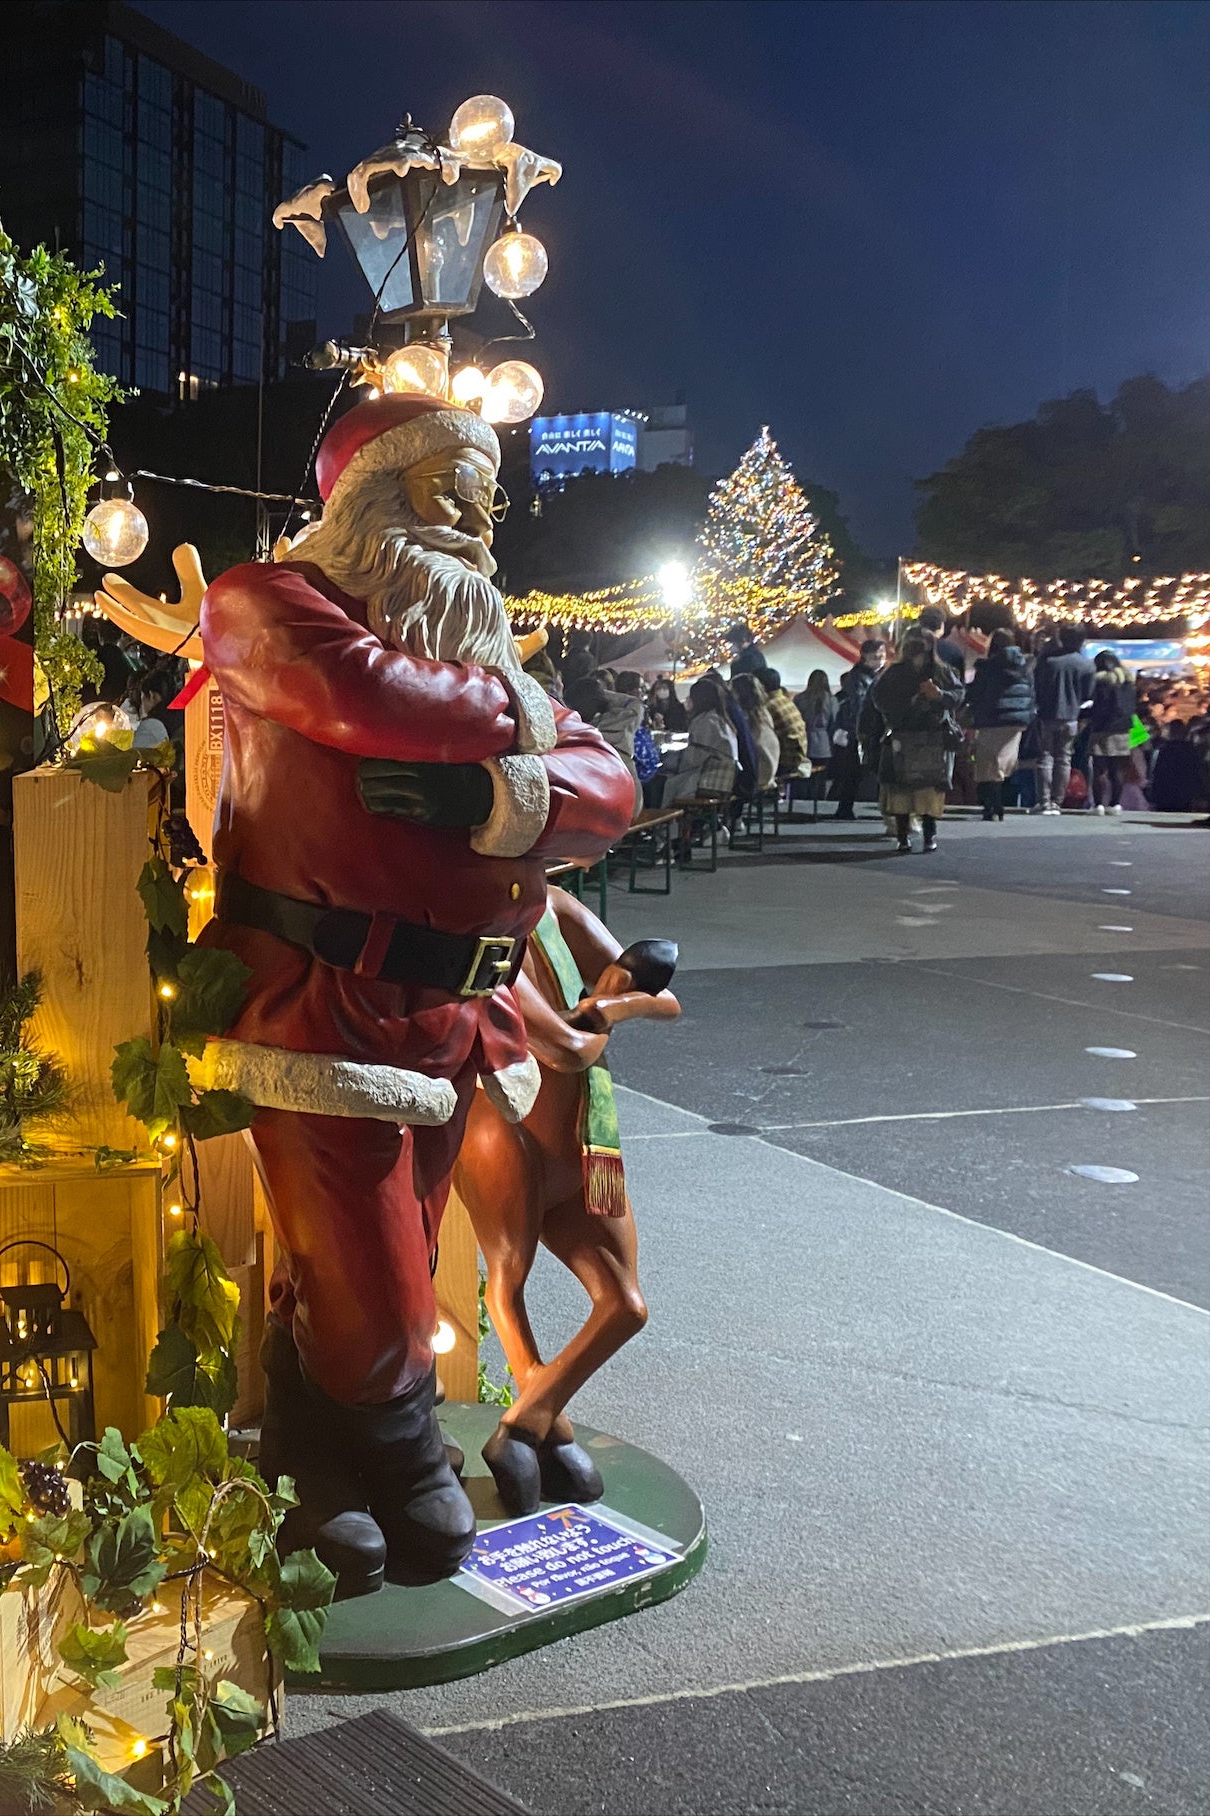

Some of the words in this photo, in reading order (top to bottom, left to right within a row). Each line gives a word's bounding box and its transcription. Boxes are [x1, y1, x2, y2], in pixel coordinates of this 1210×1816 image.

[535, 440, 606, 455] AVANTIA
[493, 1564, 545, 1588] Please
[545, 1556, 566, 1572] do
[569, 1549, 593, 1564] not
[594, 1536, 636, 1556] touch
